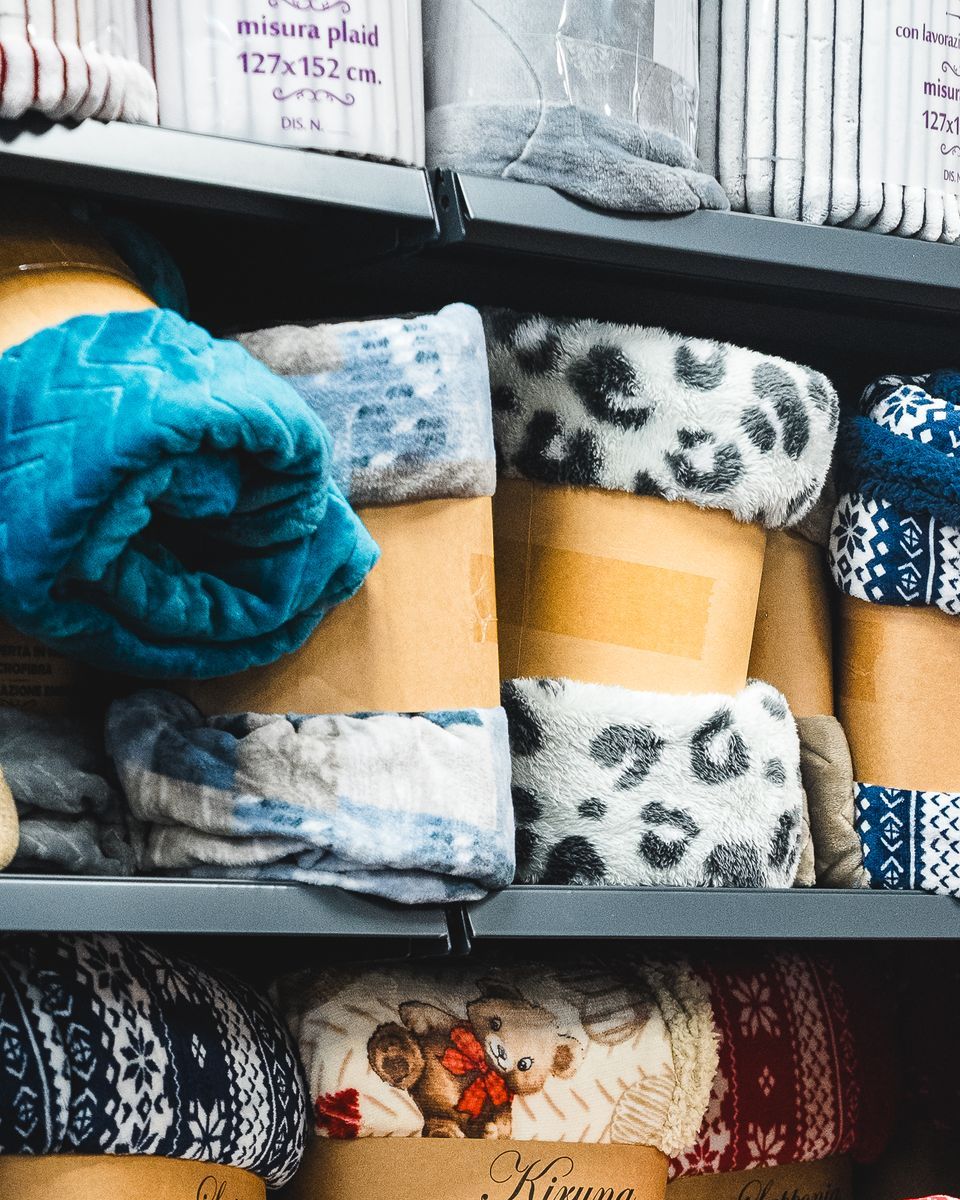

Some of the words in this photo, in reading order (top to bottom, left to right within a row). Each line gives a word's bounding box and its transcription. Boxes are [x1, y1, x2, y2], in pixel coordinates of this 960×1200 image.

[237, 15, 320, 39] misura
[328, 19, 379, 49] plaid
[896, 25, 919, 40] con
[238, 53, 340, 79] 127x152
[347, 66, 382, 85] cm.
[281, 116, 304, 130] DIS.
